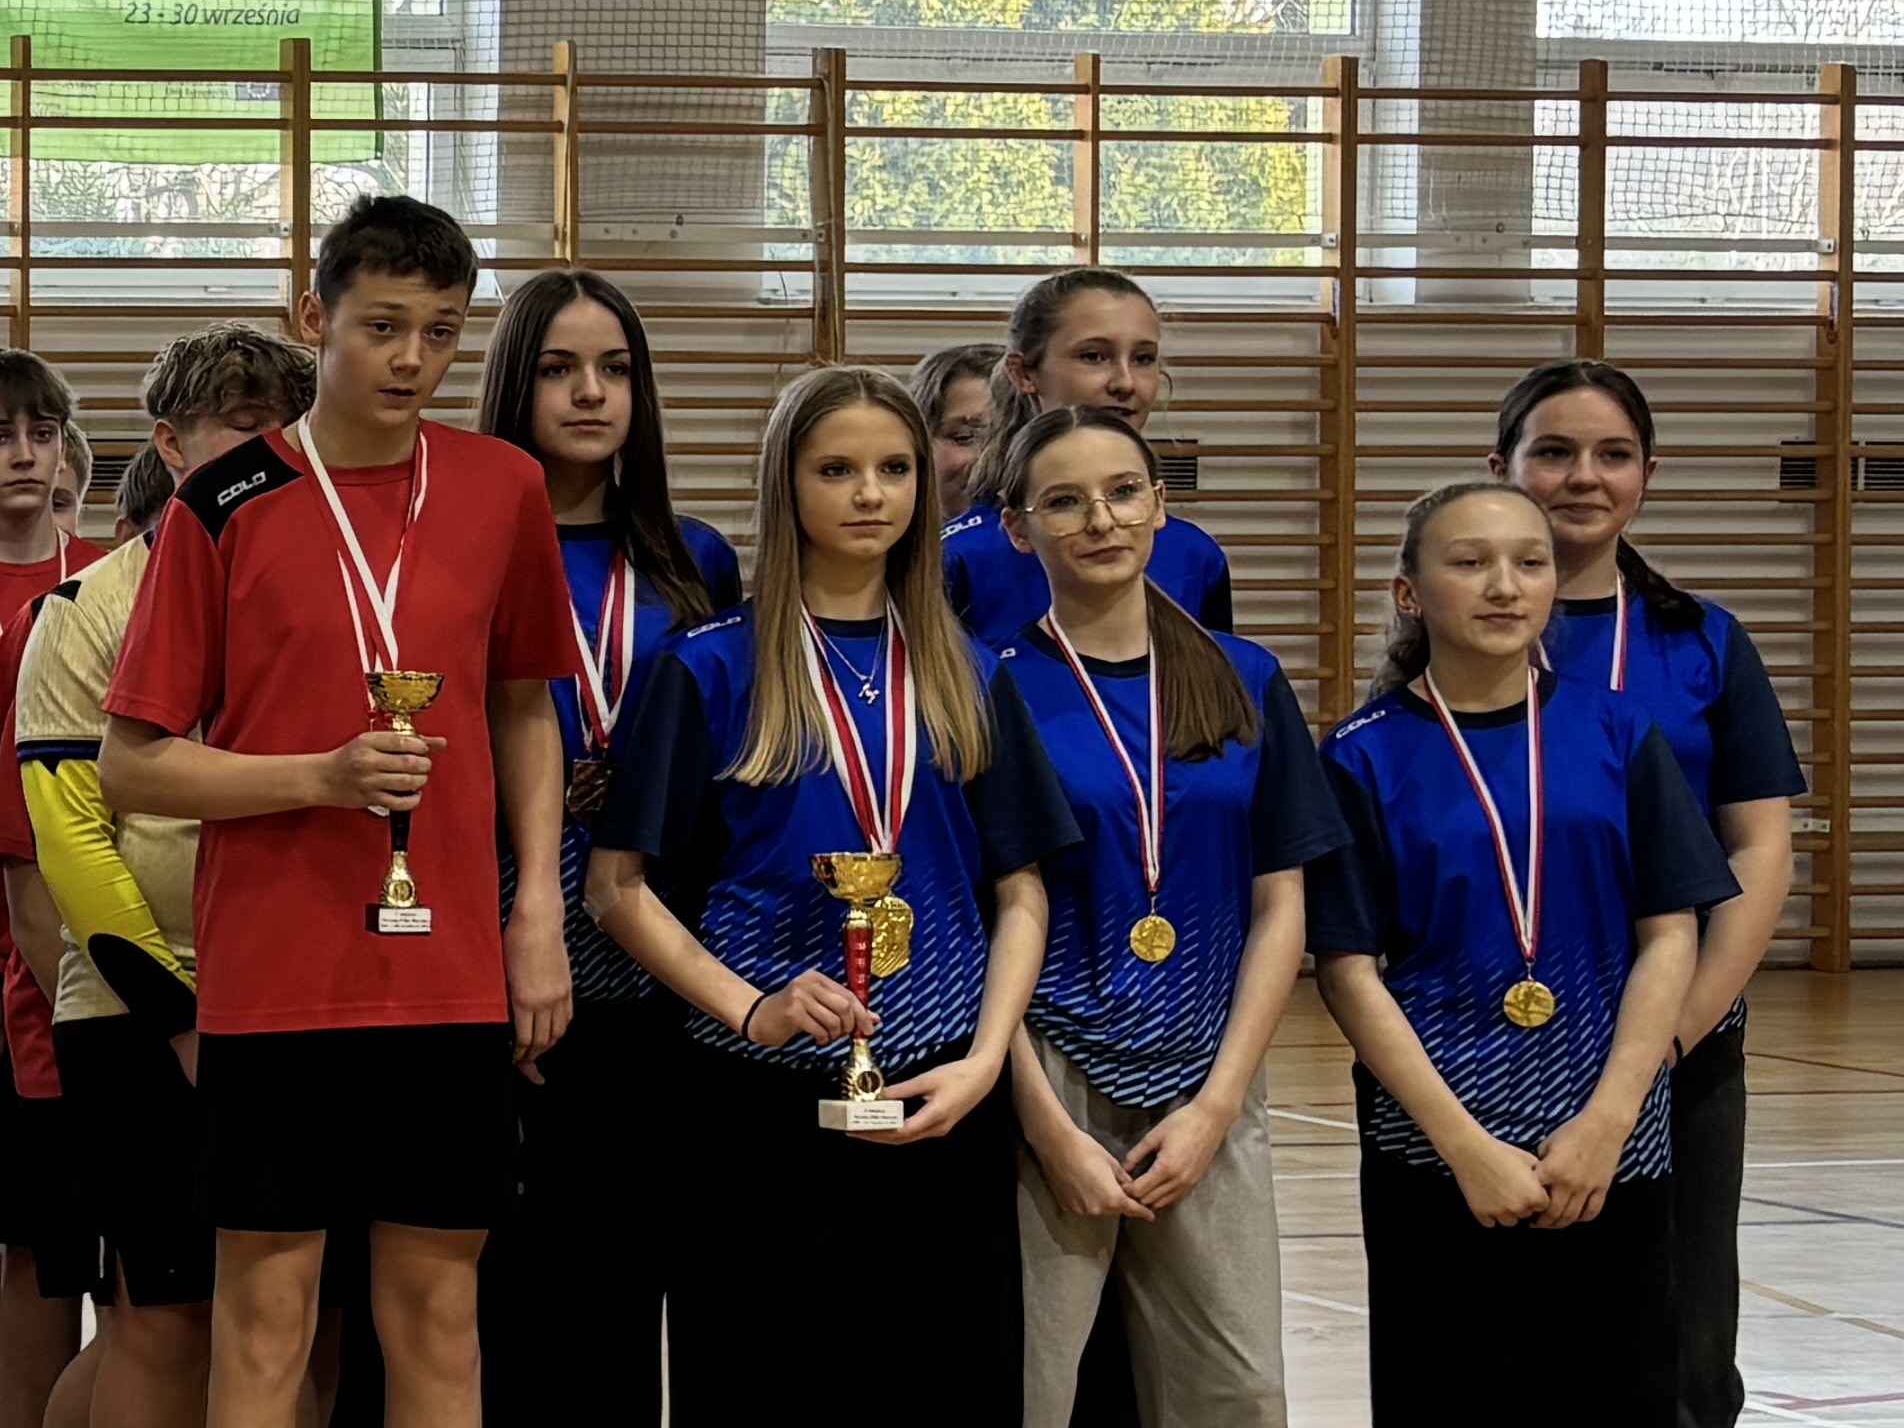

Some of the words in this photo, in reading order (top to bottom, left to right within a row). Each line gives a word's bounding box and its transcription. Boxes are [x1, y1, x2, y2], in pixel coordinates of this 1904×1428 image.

[123, 2, 151, 25] 23
[172, 2, 199, 25] 30
[200, 2, 301, 26] września
[216, 471, 267, 507] COLO
[1335, 709, 1387, 740] COLO
